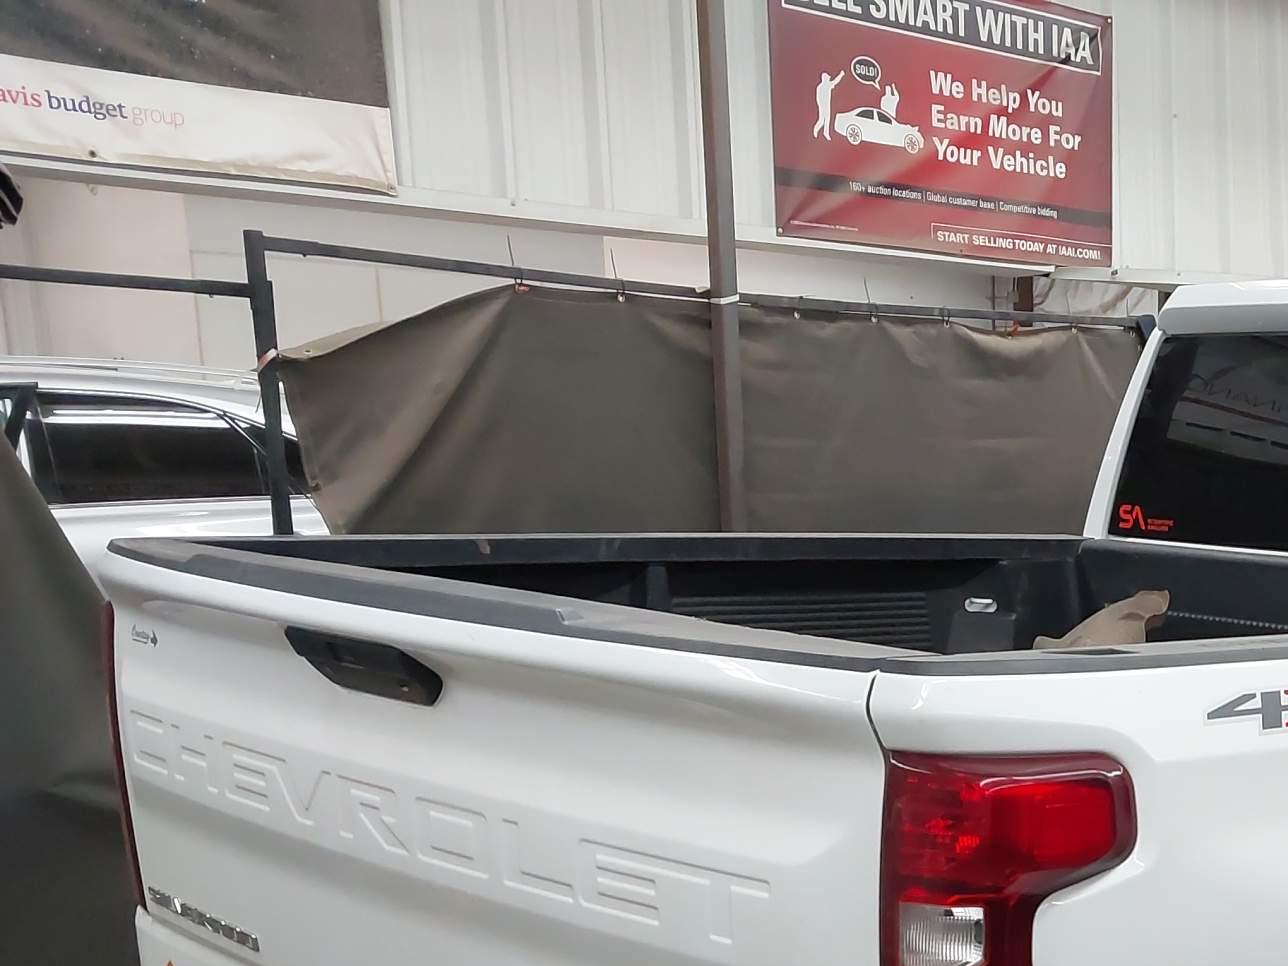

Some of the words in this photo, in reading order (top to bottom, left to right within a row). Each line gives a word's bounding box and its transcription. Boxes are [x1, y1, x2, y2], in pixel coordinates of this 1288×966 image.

[869, 0, 970, 37] SMART
[975, 6, 1045, 55] WITH
[1052, 23, 1094, 65] IAA
[855, 63, 878, 79] SOLD!
[45, 89, 128, 120] budget
[131, 105, 185, 129] group
[929, 69, 964, 99] We
[971, 78, 1021, 113] Help
[1027, 88, 1063, 117] You
[931, 103, 982, 135] Earn
[988, 113, 1042, 145] More
[1049, 124, 1082, 150] For
[932, 136, 981, 166] Your
[987, 145, 1067, 179] Vehicle
[867, 184, 892, 196] auction
[892, 186, 922, 200] locations
[926, 191, 948, 203] Global
[948, 195, 978, 208] customer
[979, 199, 995, 210] base
[999, 201, 1036, 215] Competitive
[1037, 206, 1058, 220] bidding
[937, 230, 970, 245] START
[972, 234, 1017, 250] SELLING
[1014, 239, 1045, 253] TODAY
[1046, 244, 1058, 255] AT
[1058, 245, 1101, 261] IAAI.COM!
[130, 709, 771, 945] CHEVROLET
